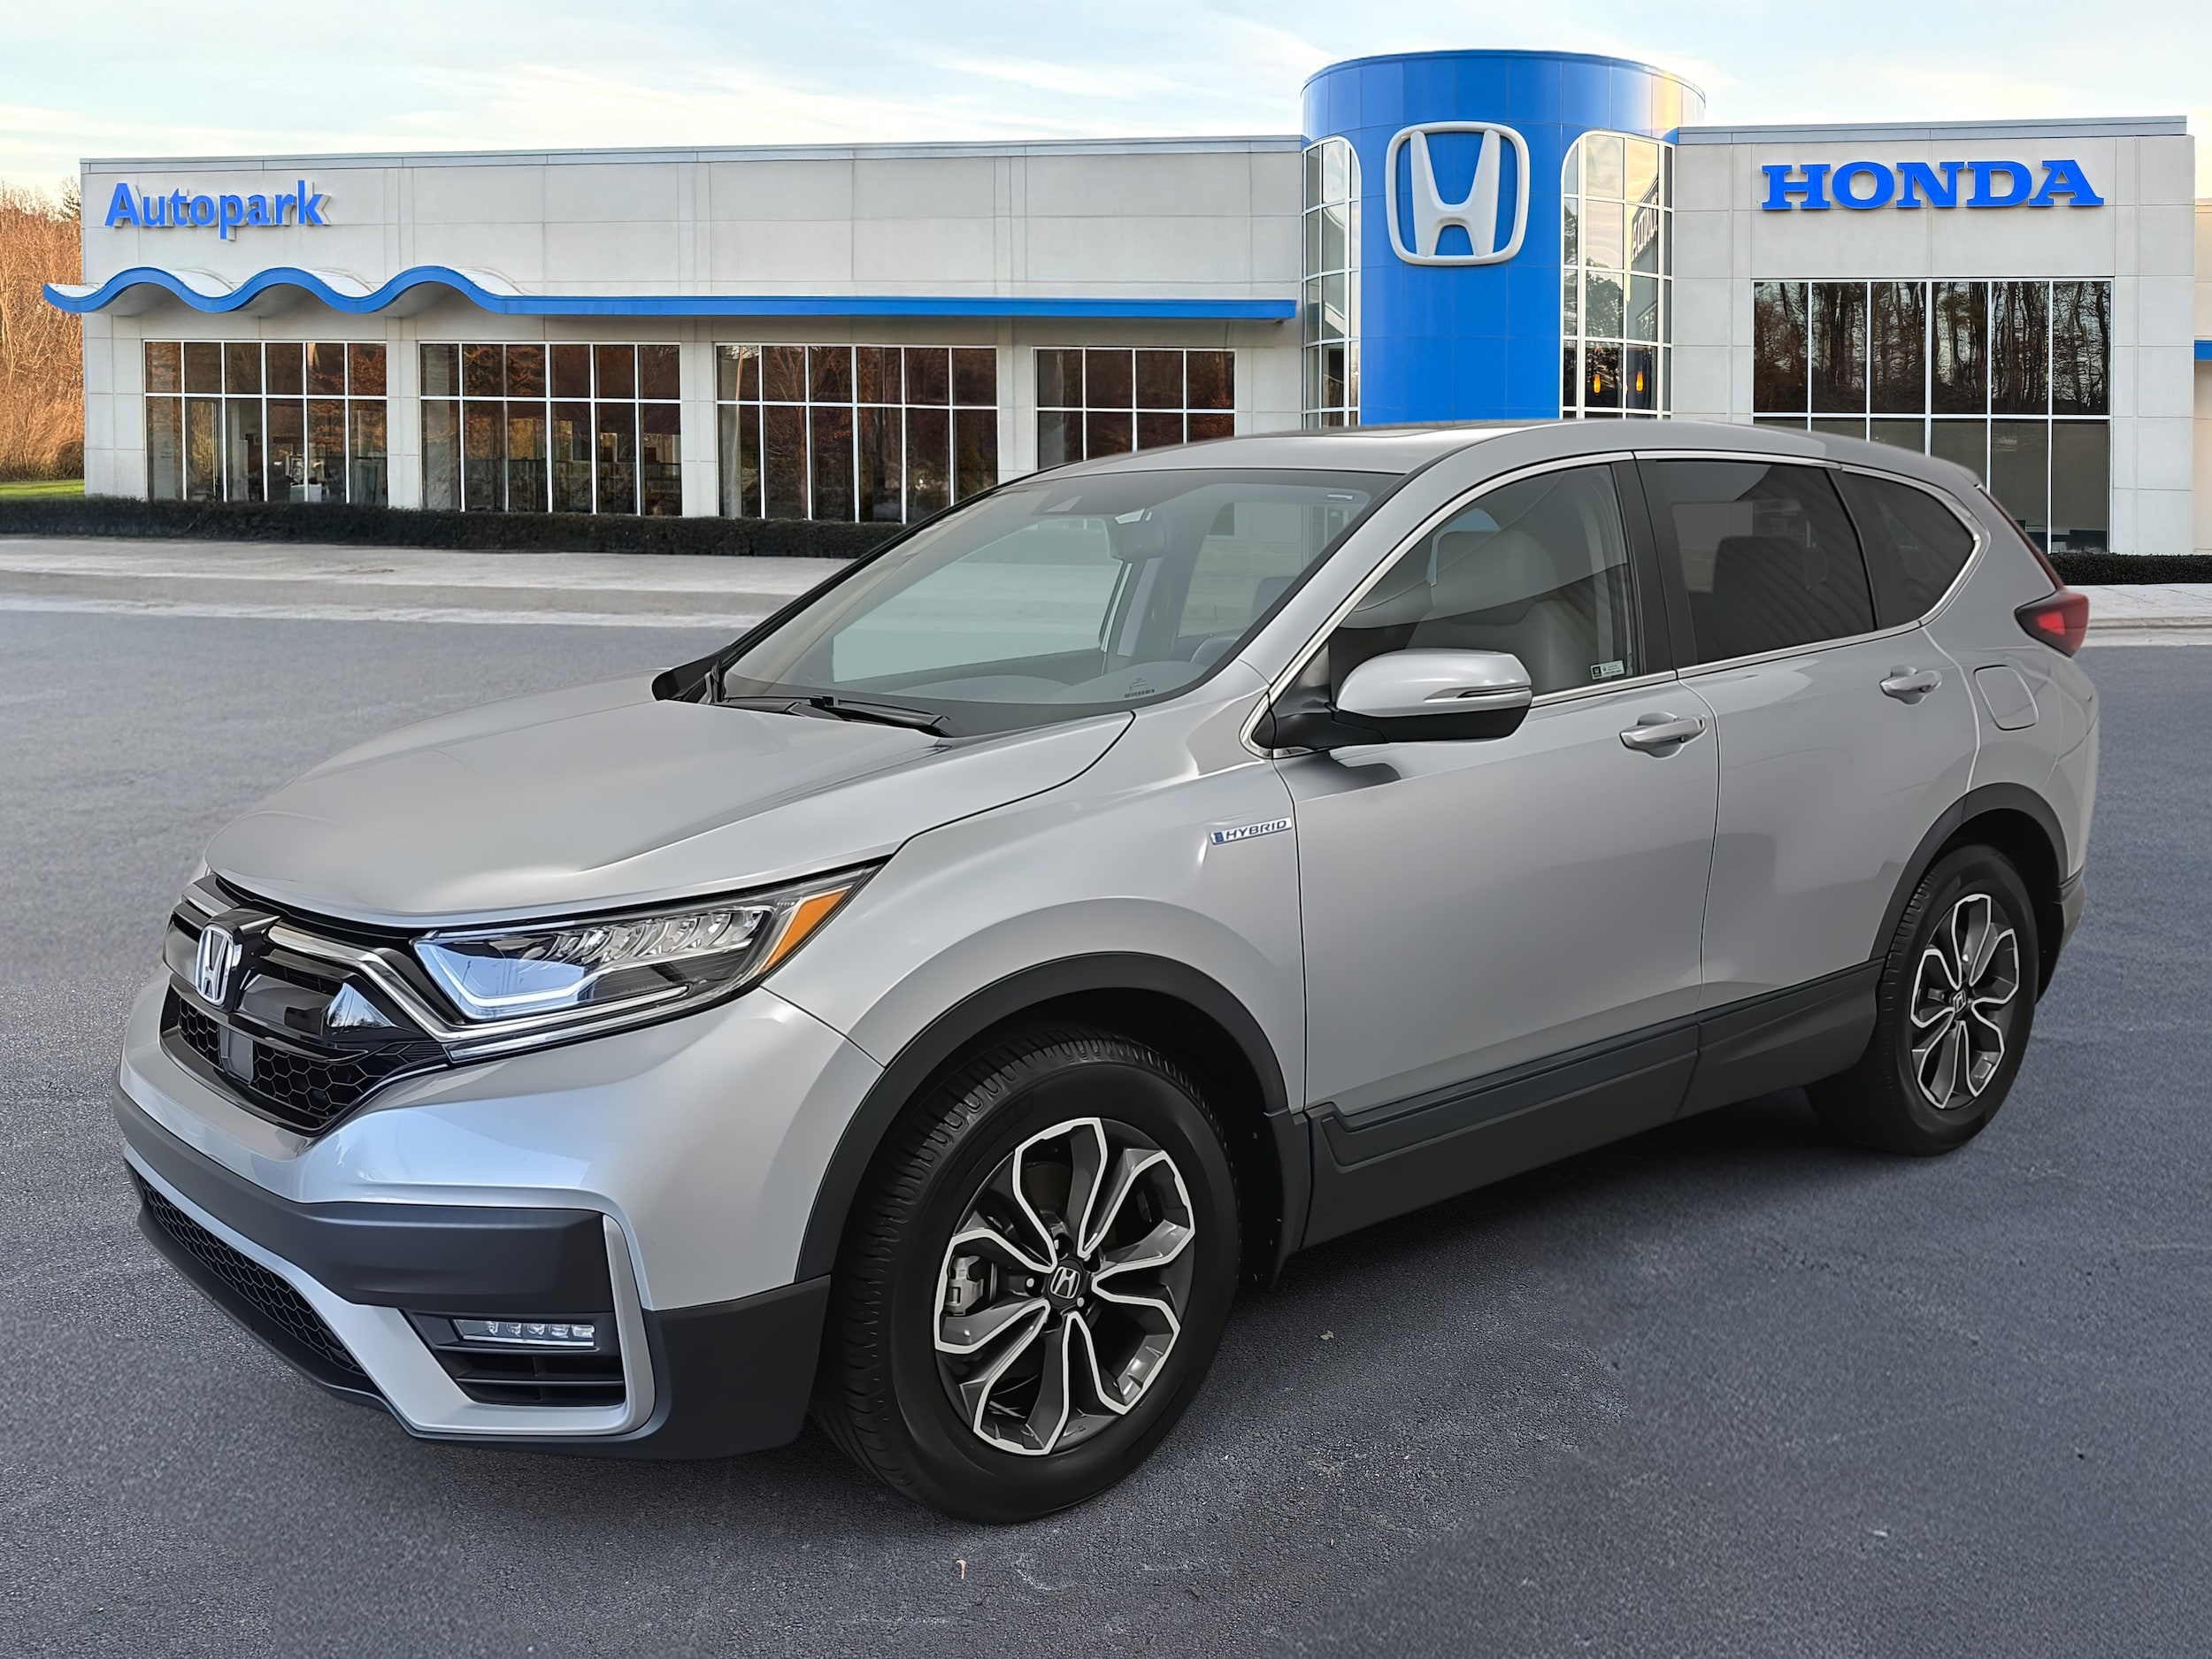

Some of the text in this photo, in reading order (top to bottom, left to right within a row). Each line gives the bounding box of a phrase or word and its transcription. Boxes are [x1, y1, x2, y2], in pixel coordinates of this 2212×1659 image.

[104, 180, 326, 240] Autopark
[1762, 159, 2105, 211] HONDA
[1225, 820, 1286, 840] HYBRID
